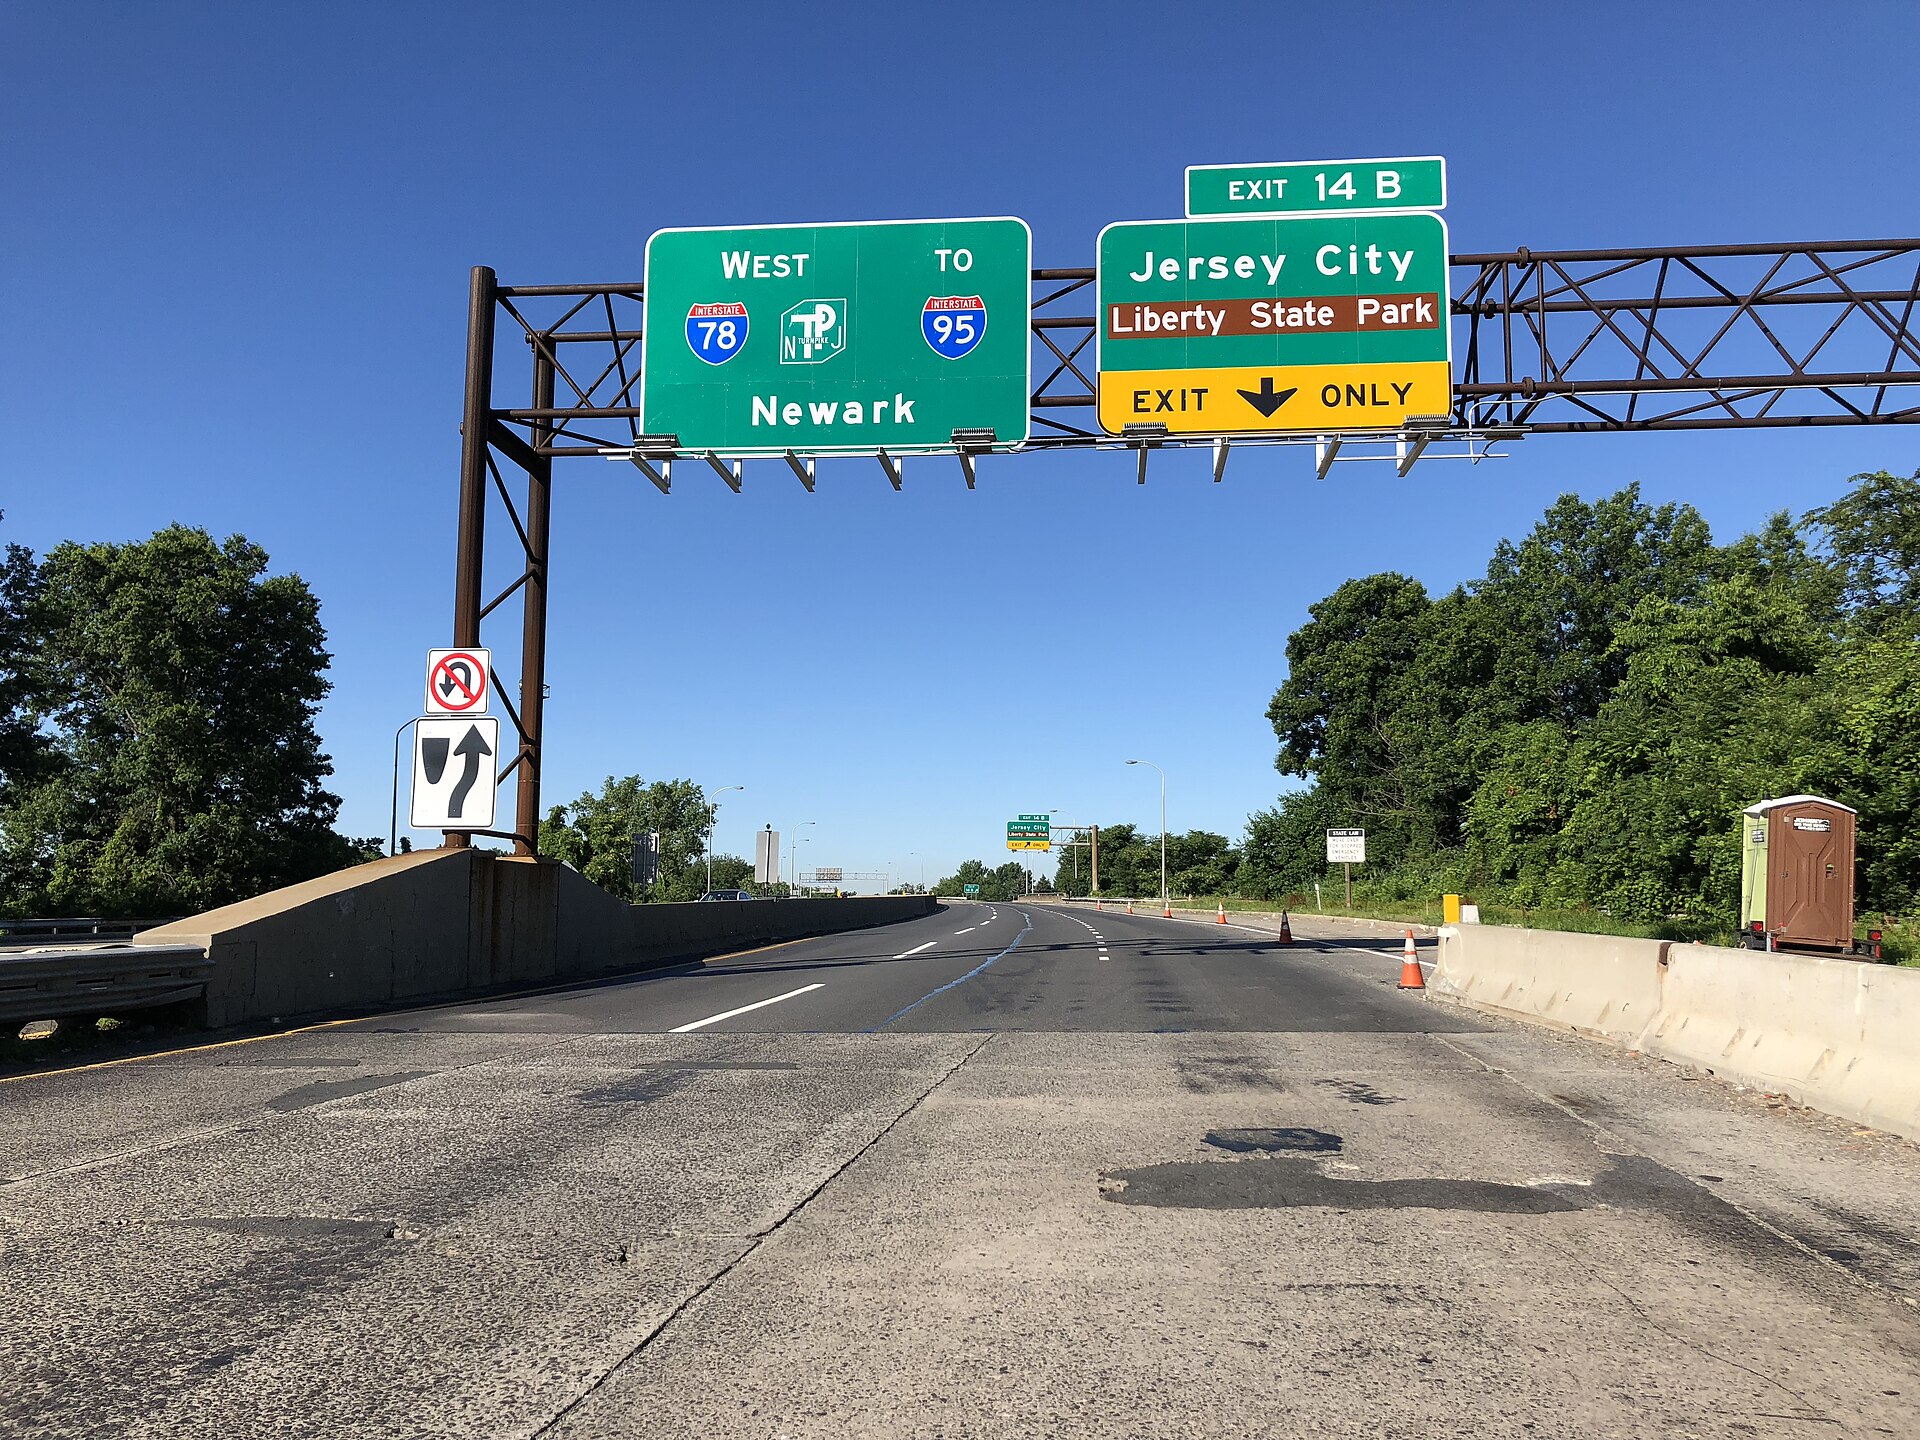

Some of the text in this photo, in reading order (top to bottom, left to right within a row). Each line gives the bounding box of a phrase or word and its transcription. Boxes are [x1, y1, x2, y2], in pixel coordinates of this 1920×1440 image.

[1229, 171, 1401, 201] EXIT 14 B
[721, 251, 810, 279] WEST
[934, 248, 973, 272] TO
[1129, 244, 1415, 286] Jersey City
[695, 305, 740, 315] INTERSTATE
[931, 299, 977, 309] INTERSTATE
[1112, 297, 1434, 336] Liberty State Park
[697, 321, 737, 350] 78
[798, 336, 829, 345] TURNPIKE
[933, 315, 975, 344] 95
[751, 393, 916, 426] Newark
[1133, 383, 1413, 413] EXIT ONLY
